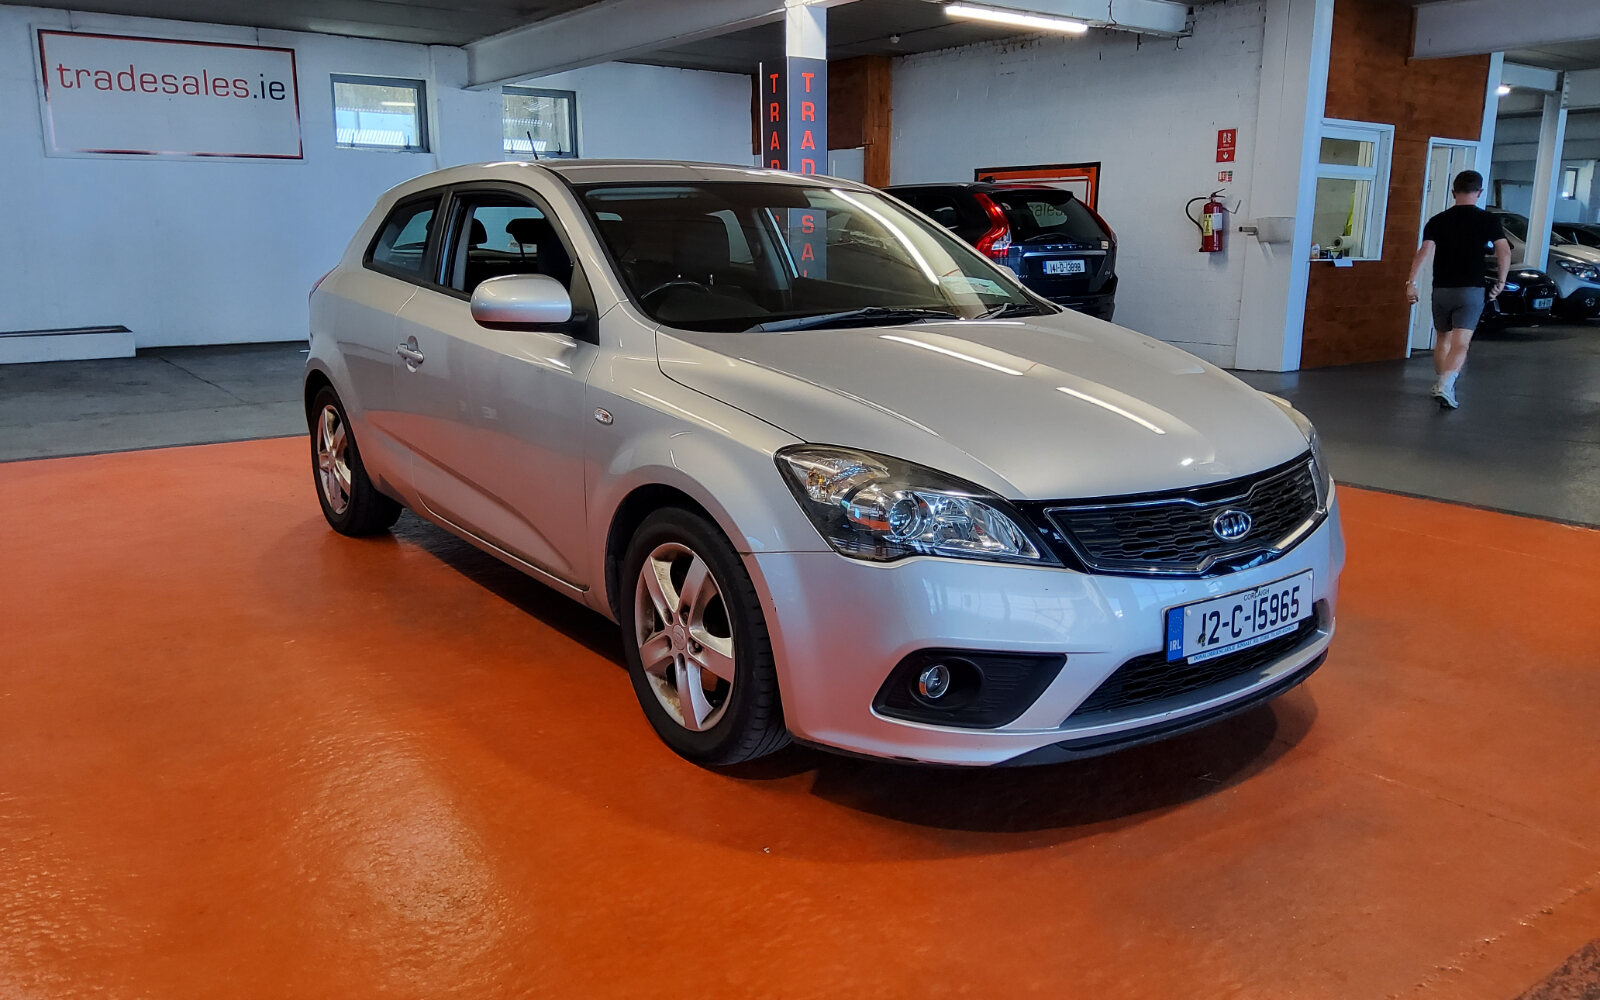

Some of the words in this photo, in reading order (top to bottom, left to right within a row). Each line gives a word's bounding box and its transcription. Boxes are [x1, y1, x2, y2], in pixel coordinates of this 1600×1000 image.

[56, 63, 287, 101] tradesales.ie
[801, 72, 816, 175] TRAD
[1220, 514, 1247, 536] KIA
[1198, 585, 1300, 648] 12-C-15965
[1170, 639, 1181, 651] IRL
